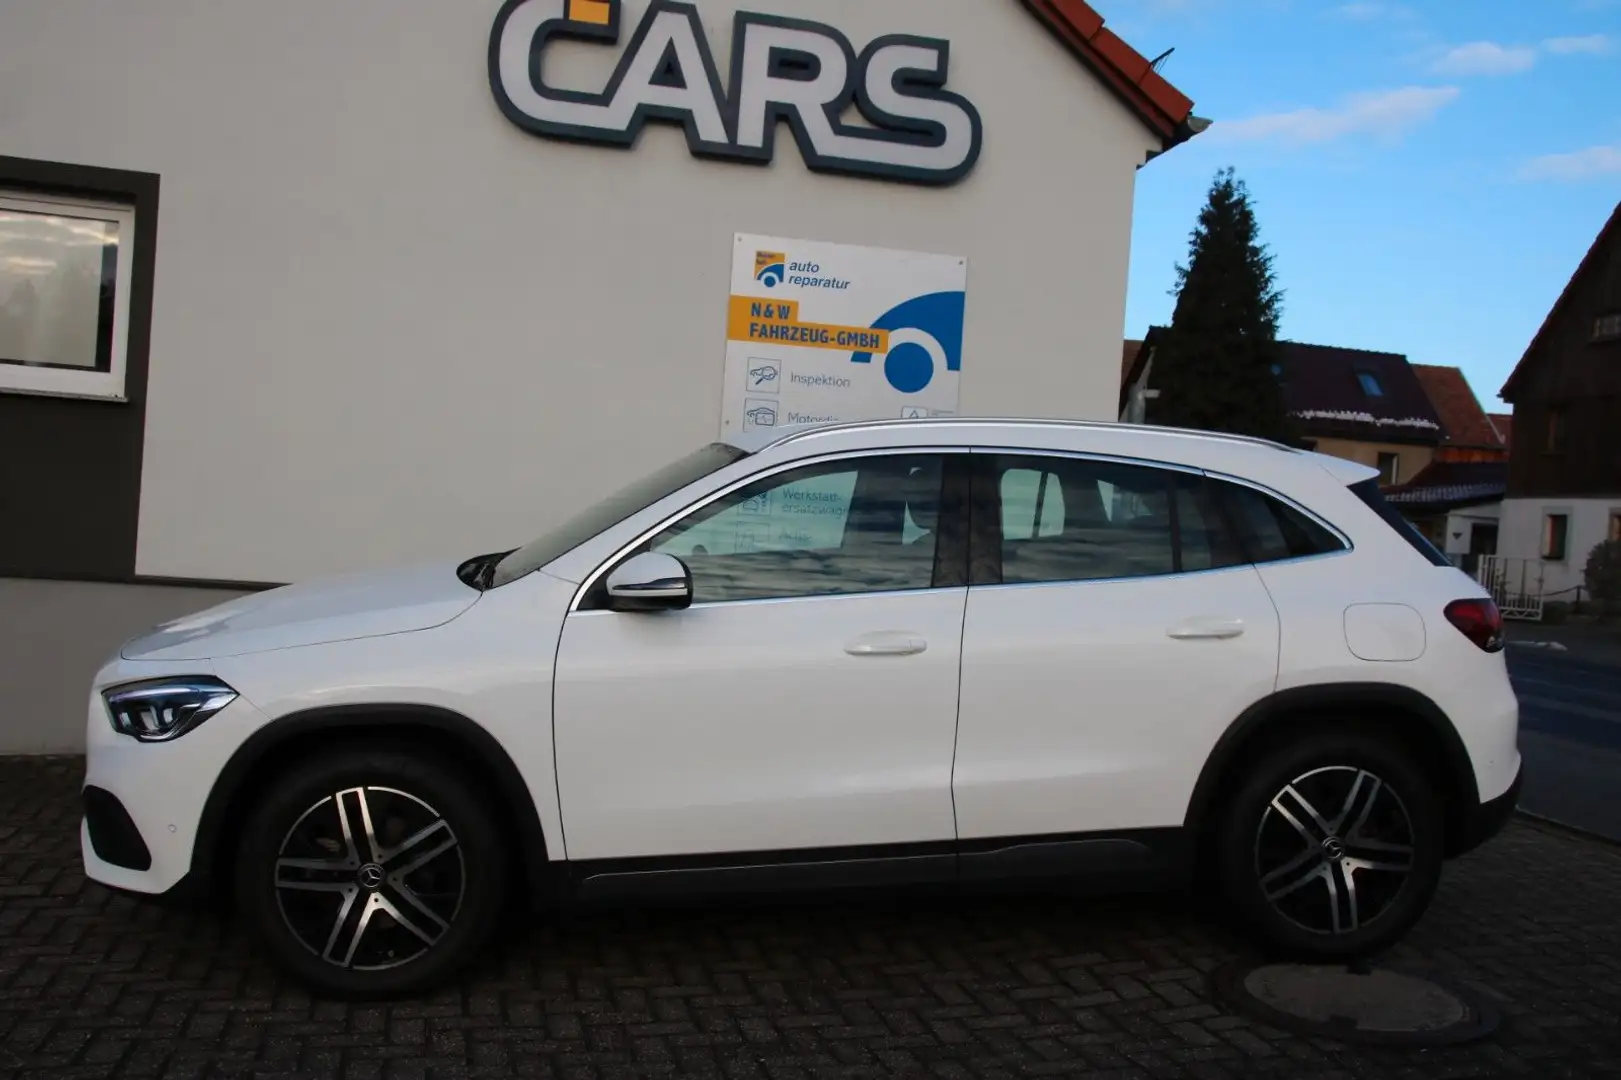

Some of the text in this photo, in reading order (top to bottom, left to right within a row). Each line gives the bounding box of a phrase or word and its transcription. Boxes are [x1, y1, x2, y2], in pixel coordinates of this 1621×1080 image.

[488, 0, 982, 185] CARS
[789, 261, 820, 273] auto
[788, 275, 851, 290] reparatur
[751, 302, 791, 320] N & W
[749, 322, 881, 349] FAHRZEUG-GMBH
[790, 371, 851, 388] Inspektion
